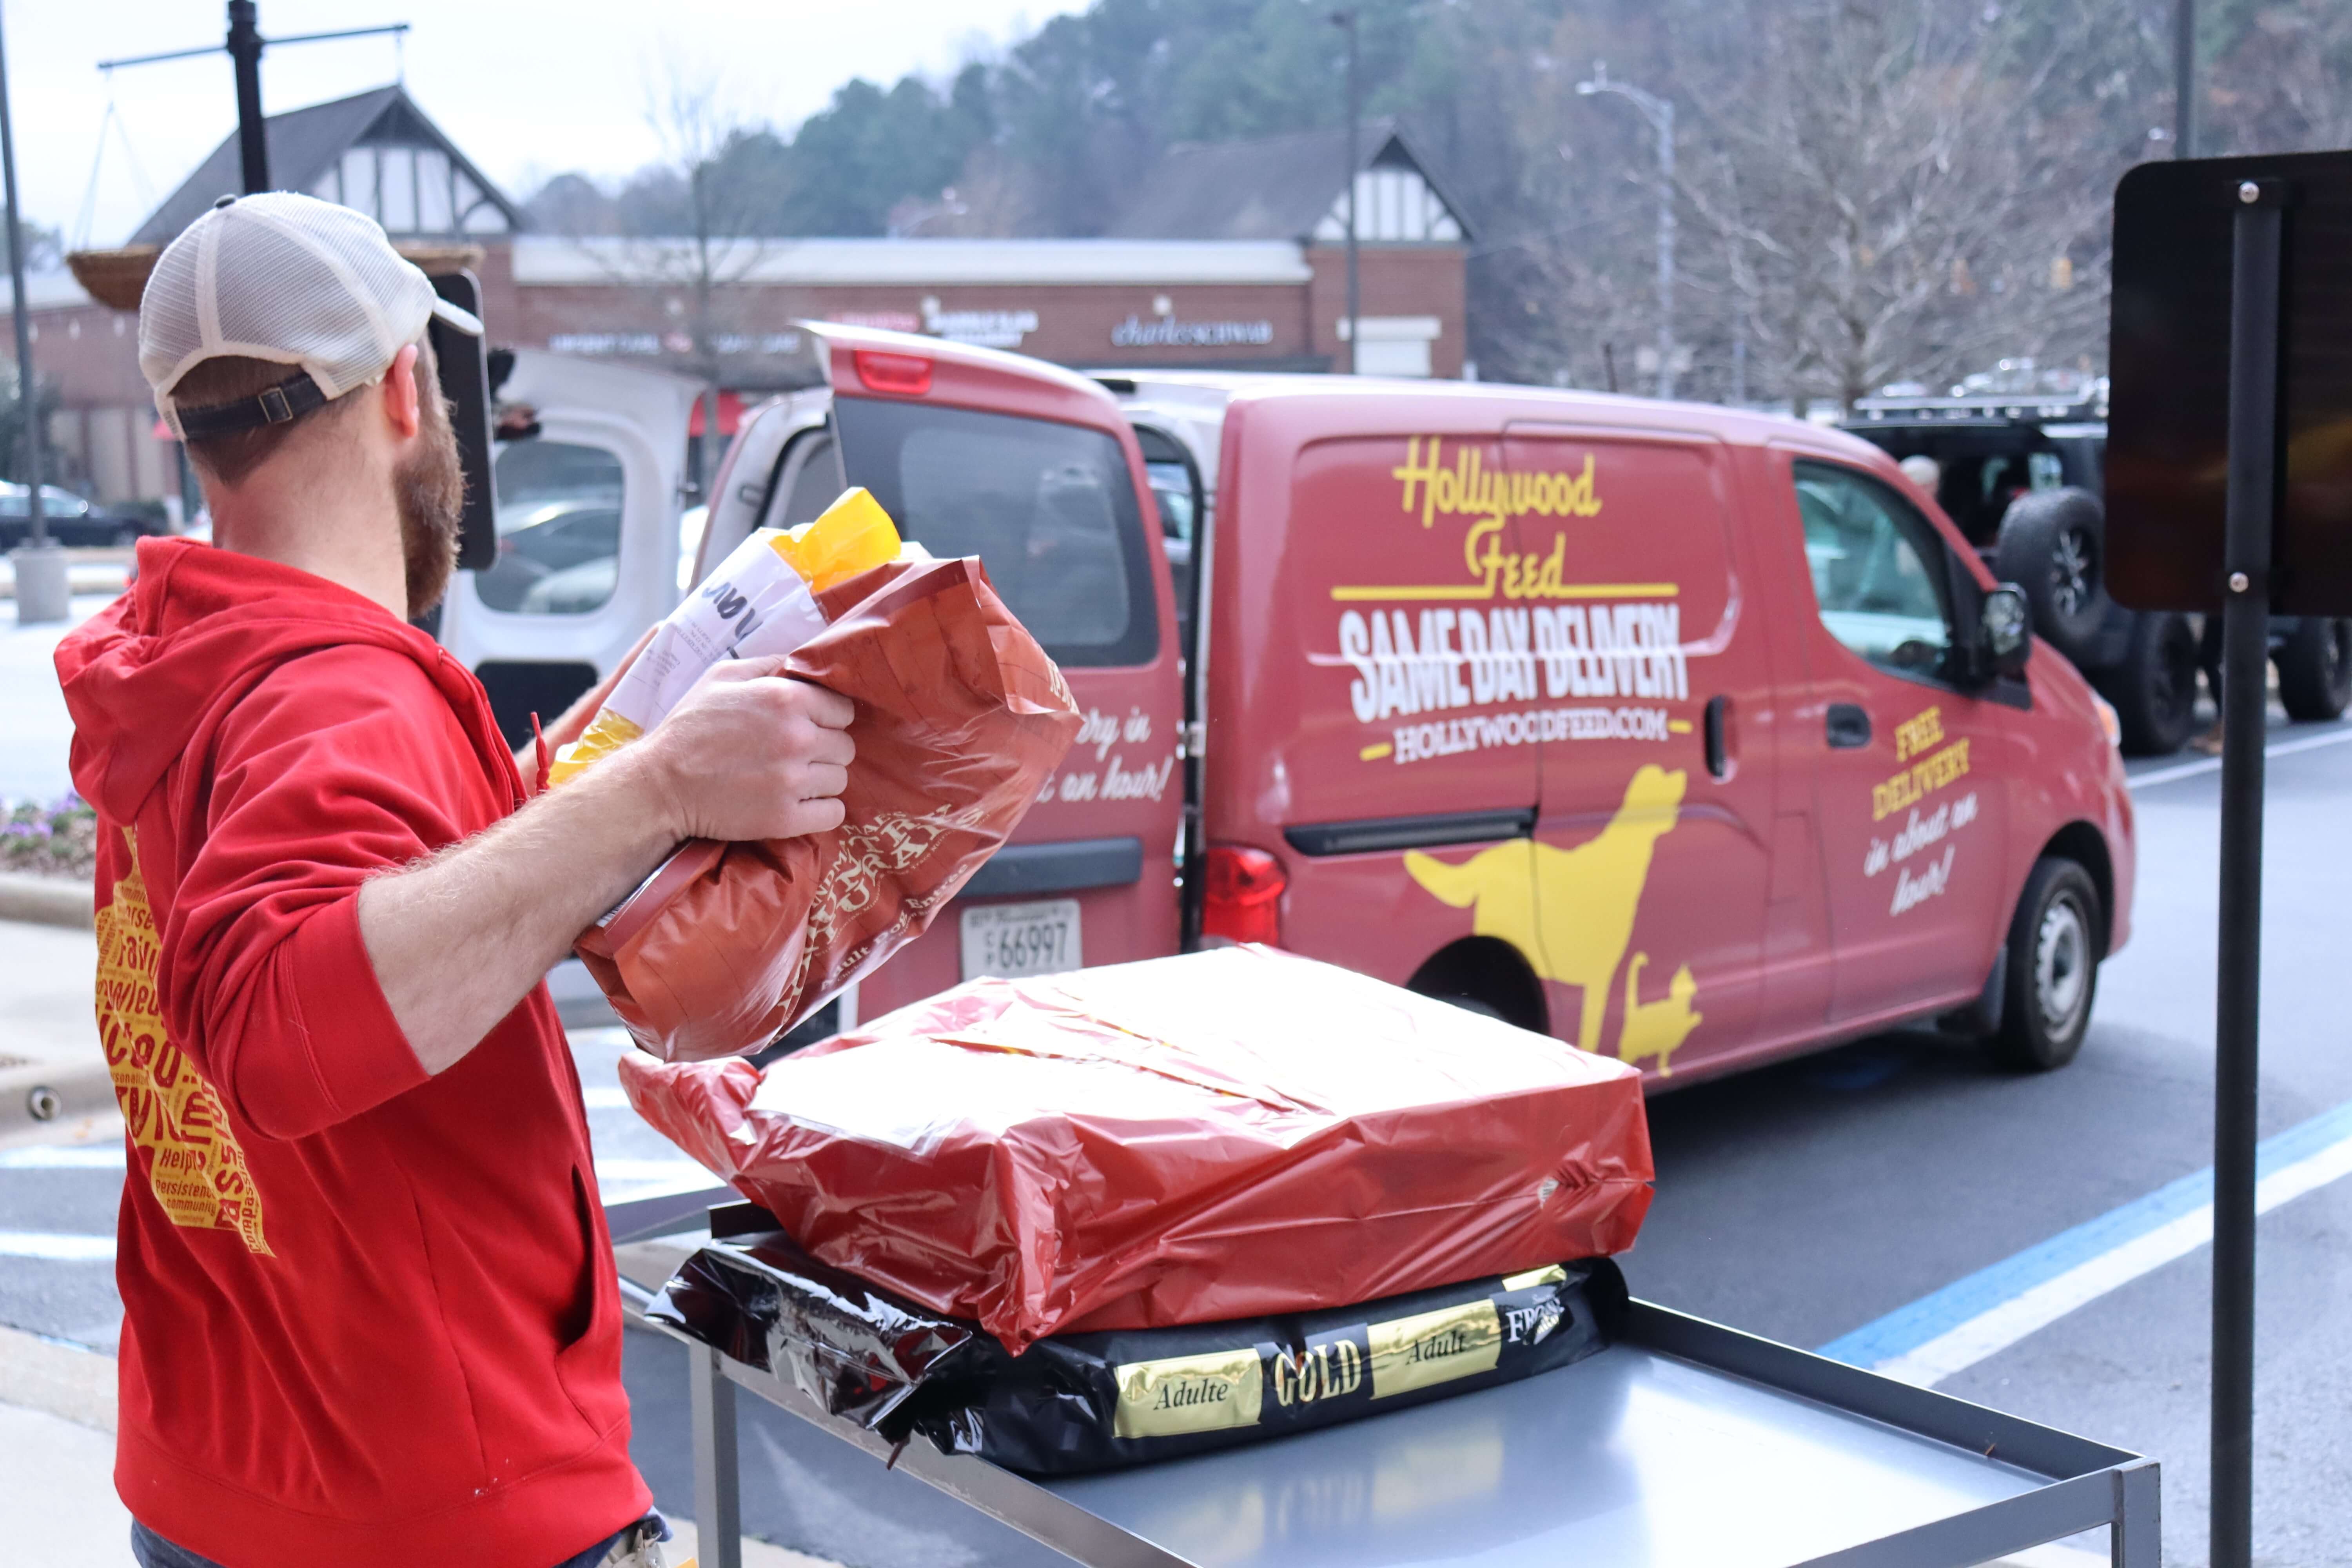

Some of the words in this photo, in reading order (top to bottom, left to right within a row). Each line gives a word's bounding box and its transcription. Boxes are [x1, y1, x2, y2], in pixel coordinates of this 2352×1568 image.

[1392, 436, 1602, 529] Hollywood
[1465, 517, 1567, 599] Feed
[1338, 609, 1470, 722] SAME
[1458, 608, 1538, 705] DAY
[1532, 603, 1689, 701] DELIVERY
[1895, 705, 1945, 763] FREE
[1059, 771, 1098, 803] an
[1098, 754, 1174, 803] hour!
[1871, 736, 1971, 822] DELIVERY
[1864, 836, 1891, 878] in
[1892, 802, 1950, 863] about
[1950, 791, 1979, 830] an
[1889, 843, 1956, 917] hour!
[873, 909, 908, 945] Dog
[167, 1198, 217, 1217] community
[1274, 1339, 1362, 1407] GOLD
[1405, 1329, 1466, 1366] Adult
[1153, 1378, 1229, 1410] Adulte
